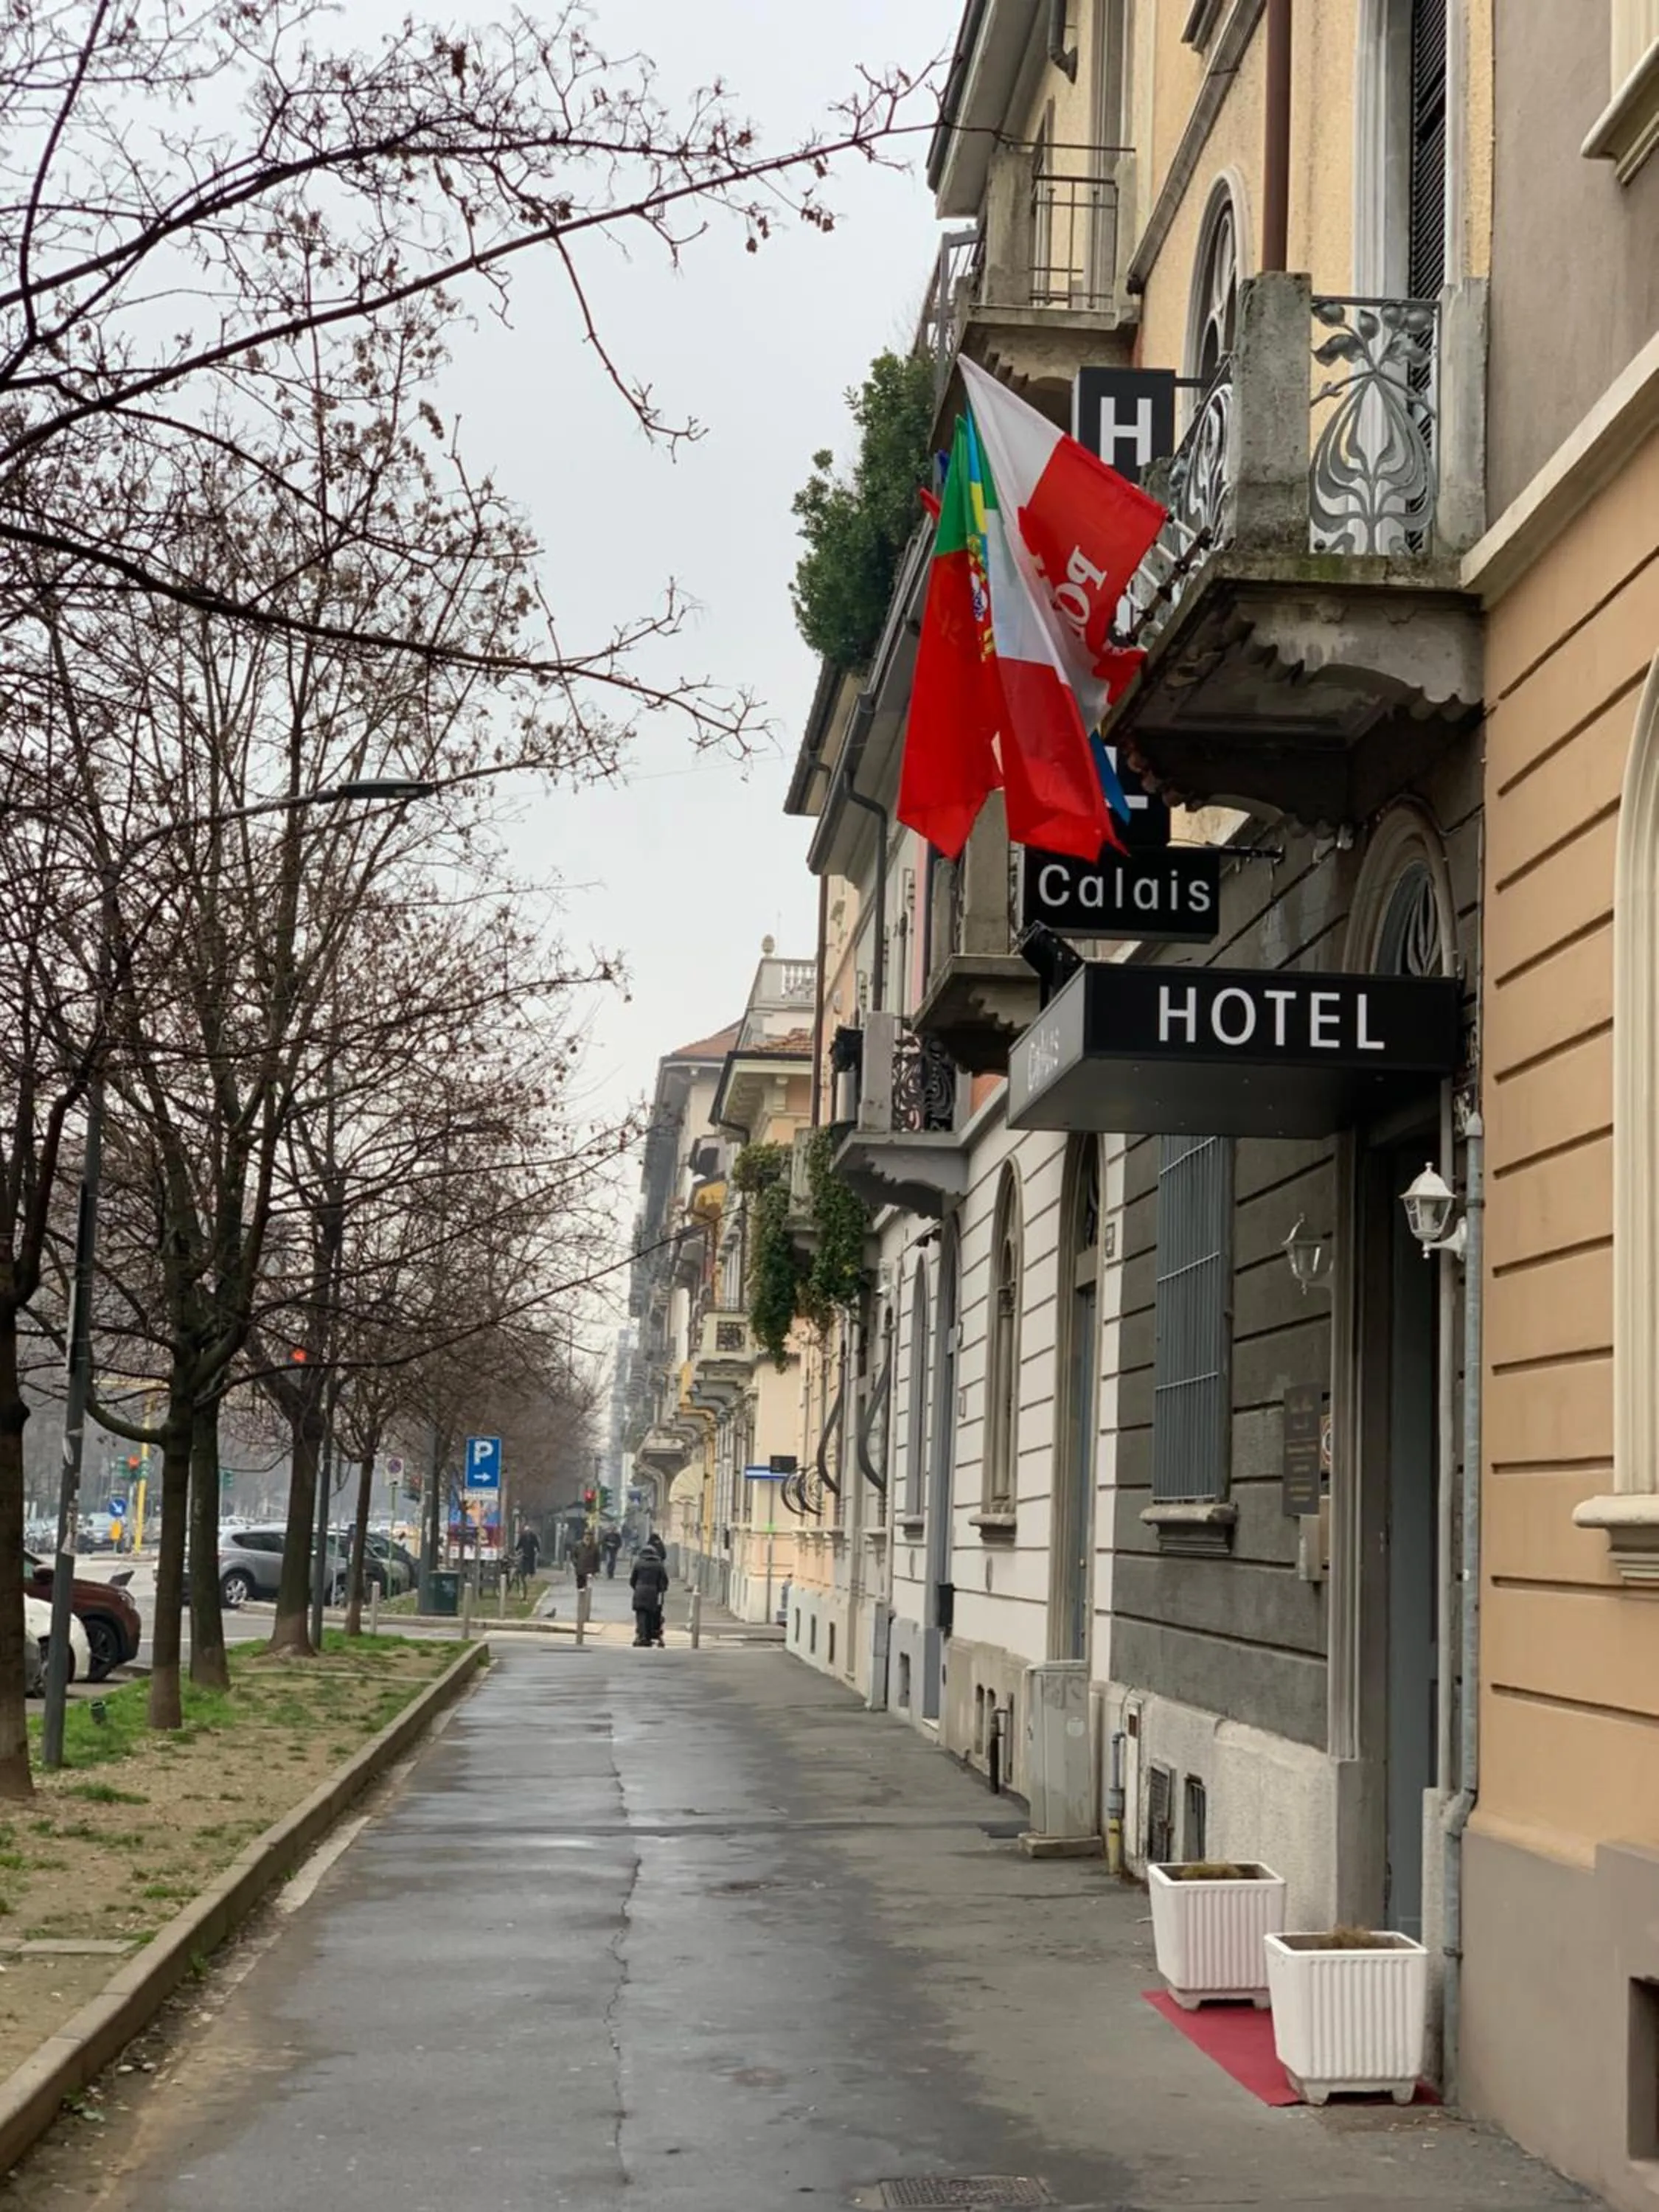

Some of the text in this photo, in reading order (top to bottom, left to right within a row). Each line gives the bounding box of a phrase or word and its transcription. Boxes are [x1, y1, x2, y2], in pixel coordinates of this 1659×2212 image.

[1037, 863, 1211, 913] Calais
[1158, 985, 1385, 1051] HOTEL
[473, 1440, 493, 1465] P
